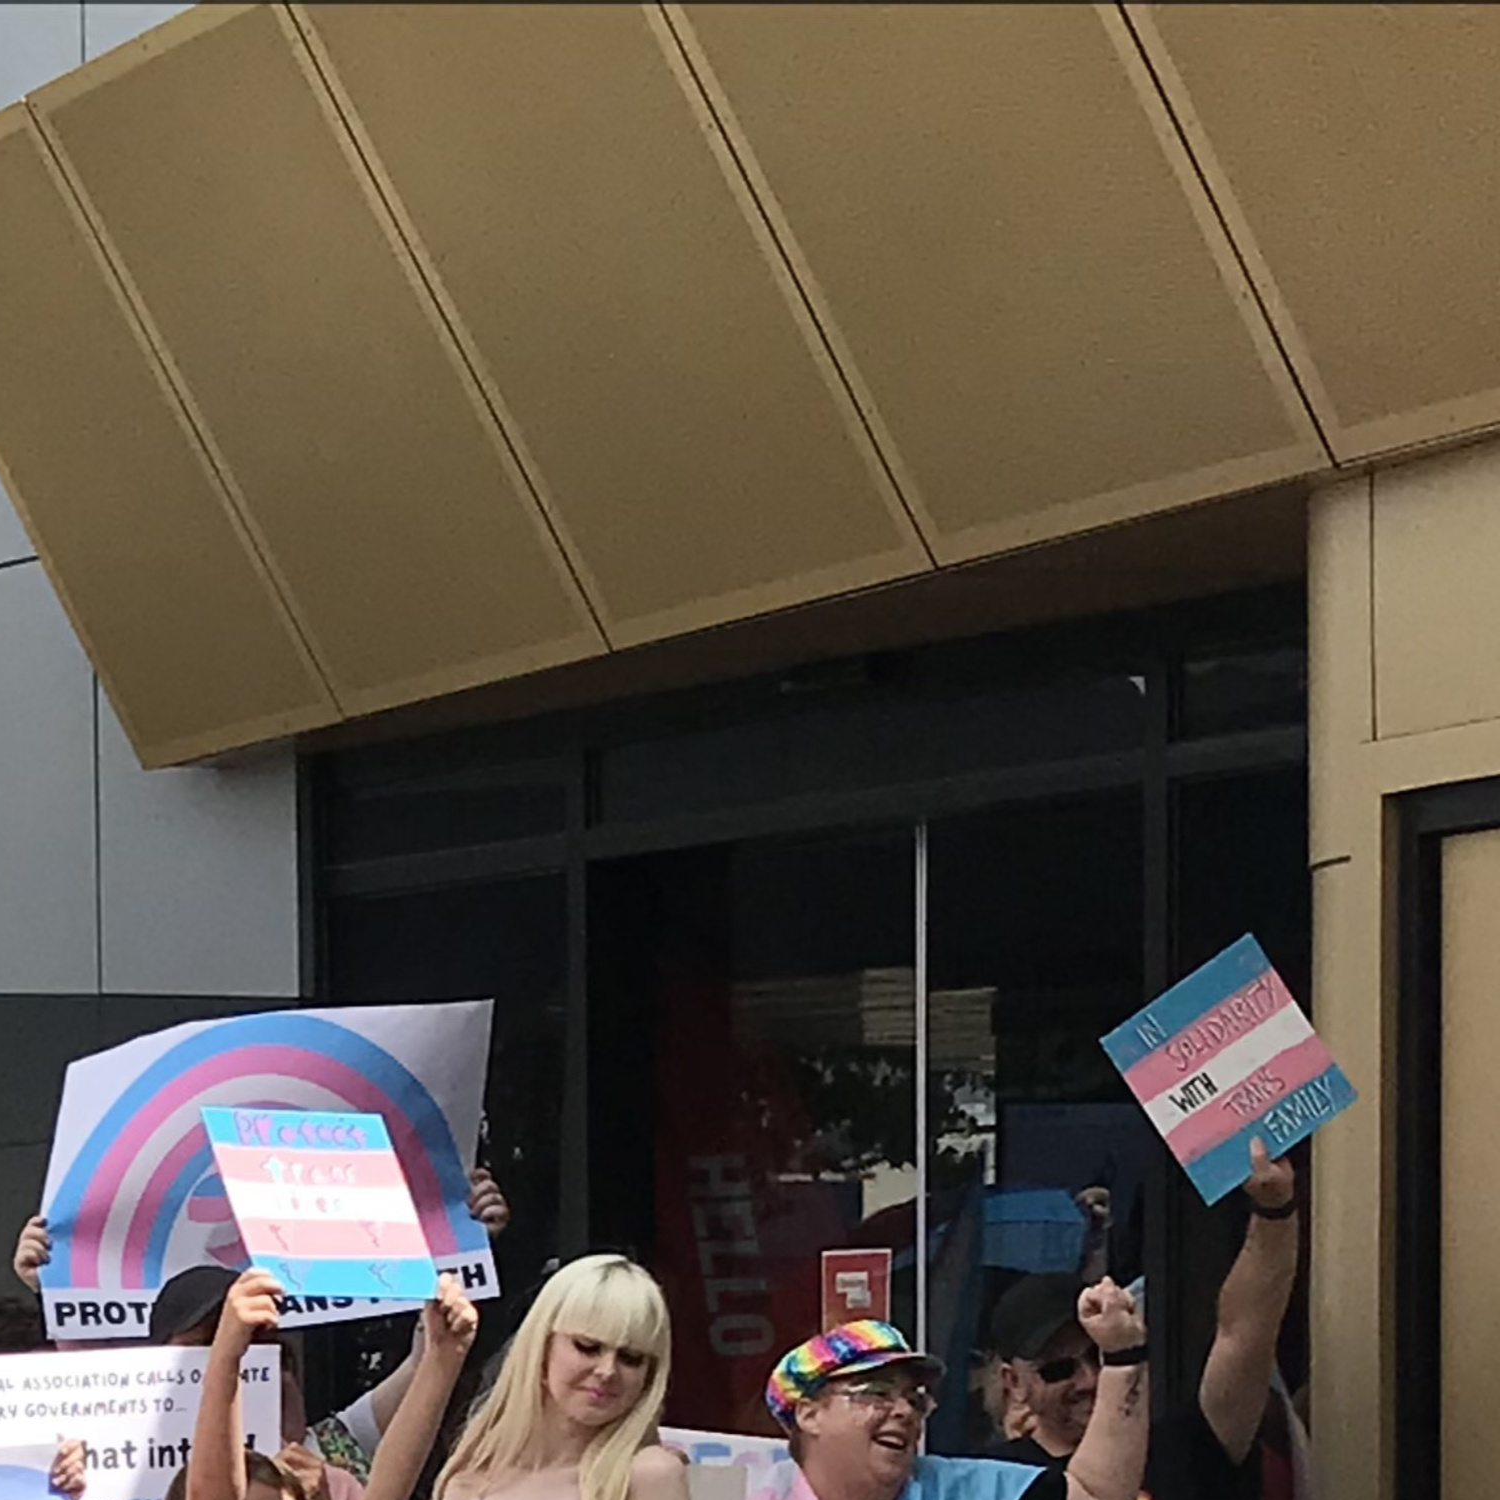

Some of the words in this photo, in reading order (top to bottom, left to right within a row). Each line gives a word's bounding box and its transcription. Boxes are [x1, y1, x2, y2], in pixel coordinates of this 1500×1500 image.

[1136, 1013, 1167, 1049] IN
[1165, 976, 1278, 1073] SOLIDARITY
[1169, 1072, 1218, 1115] WITH
[1222, 1066, 1287, 1118] TRANS
[1263, 1076, 1336, 1144] FAMILY
[54, 1301, 149, 1327] PROT
[22, 1370, 130, 1391] ASSOCIATION
[136, 1368, 186, 1387] CALLS
[24, 1398, 148, 1418] GOVERNMENTS
